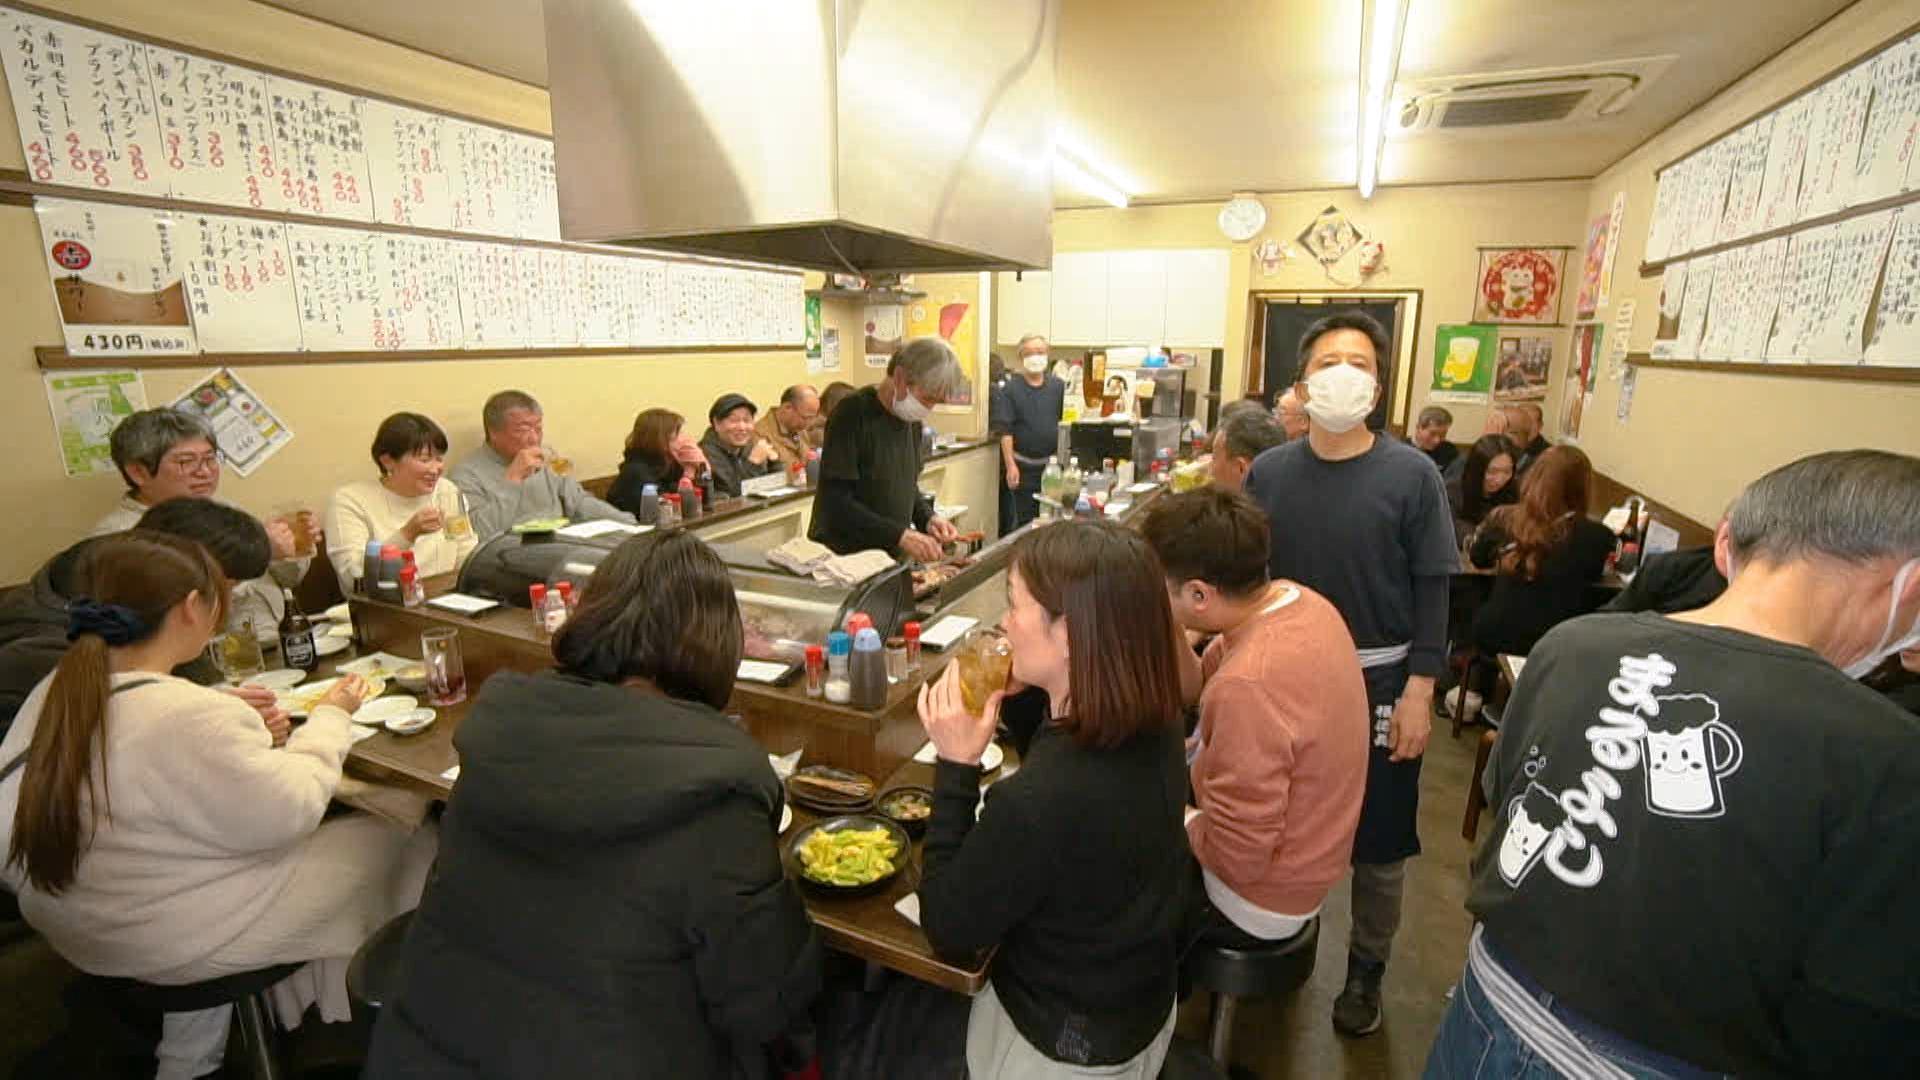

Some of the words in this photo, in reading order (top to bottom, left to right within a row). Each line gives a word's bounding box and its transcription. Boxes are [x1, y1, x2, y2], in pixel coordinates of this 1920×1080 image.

[83, 334, 144, 350] 430円
[1544, 653, 1677, 888] まるよし
